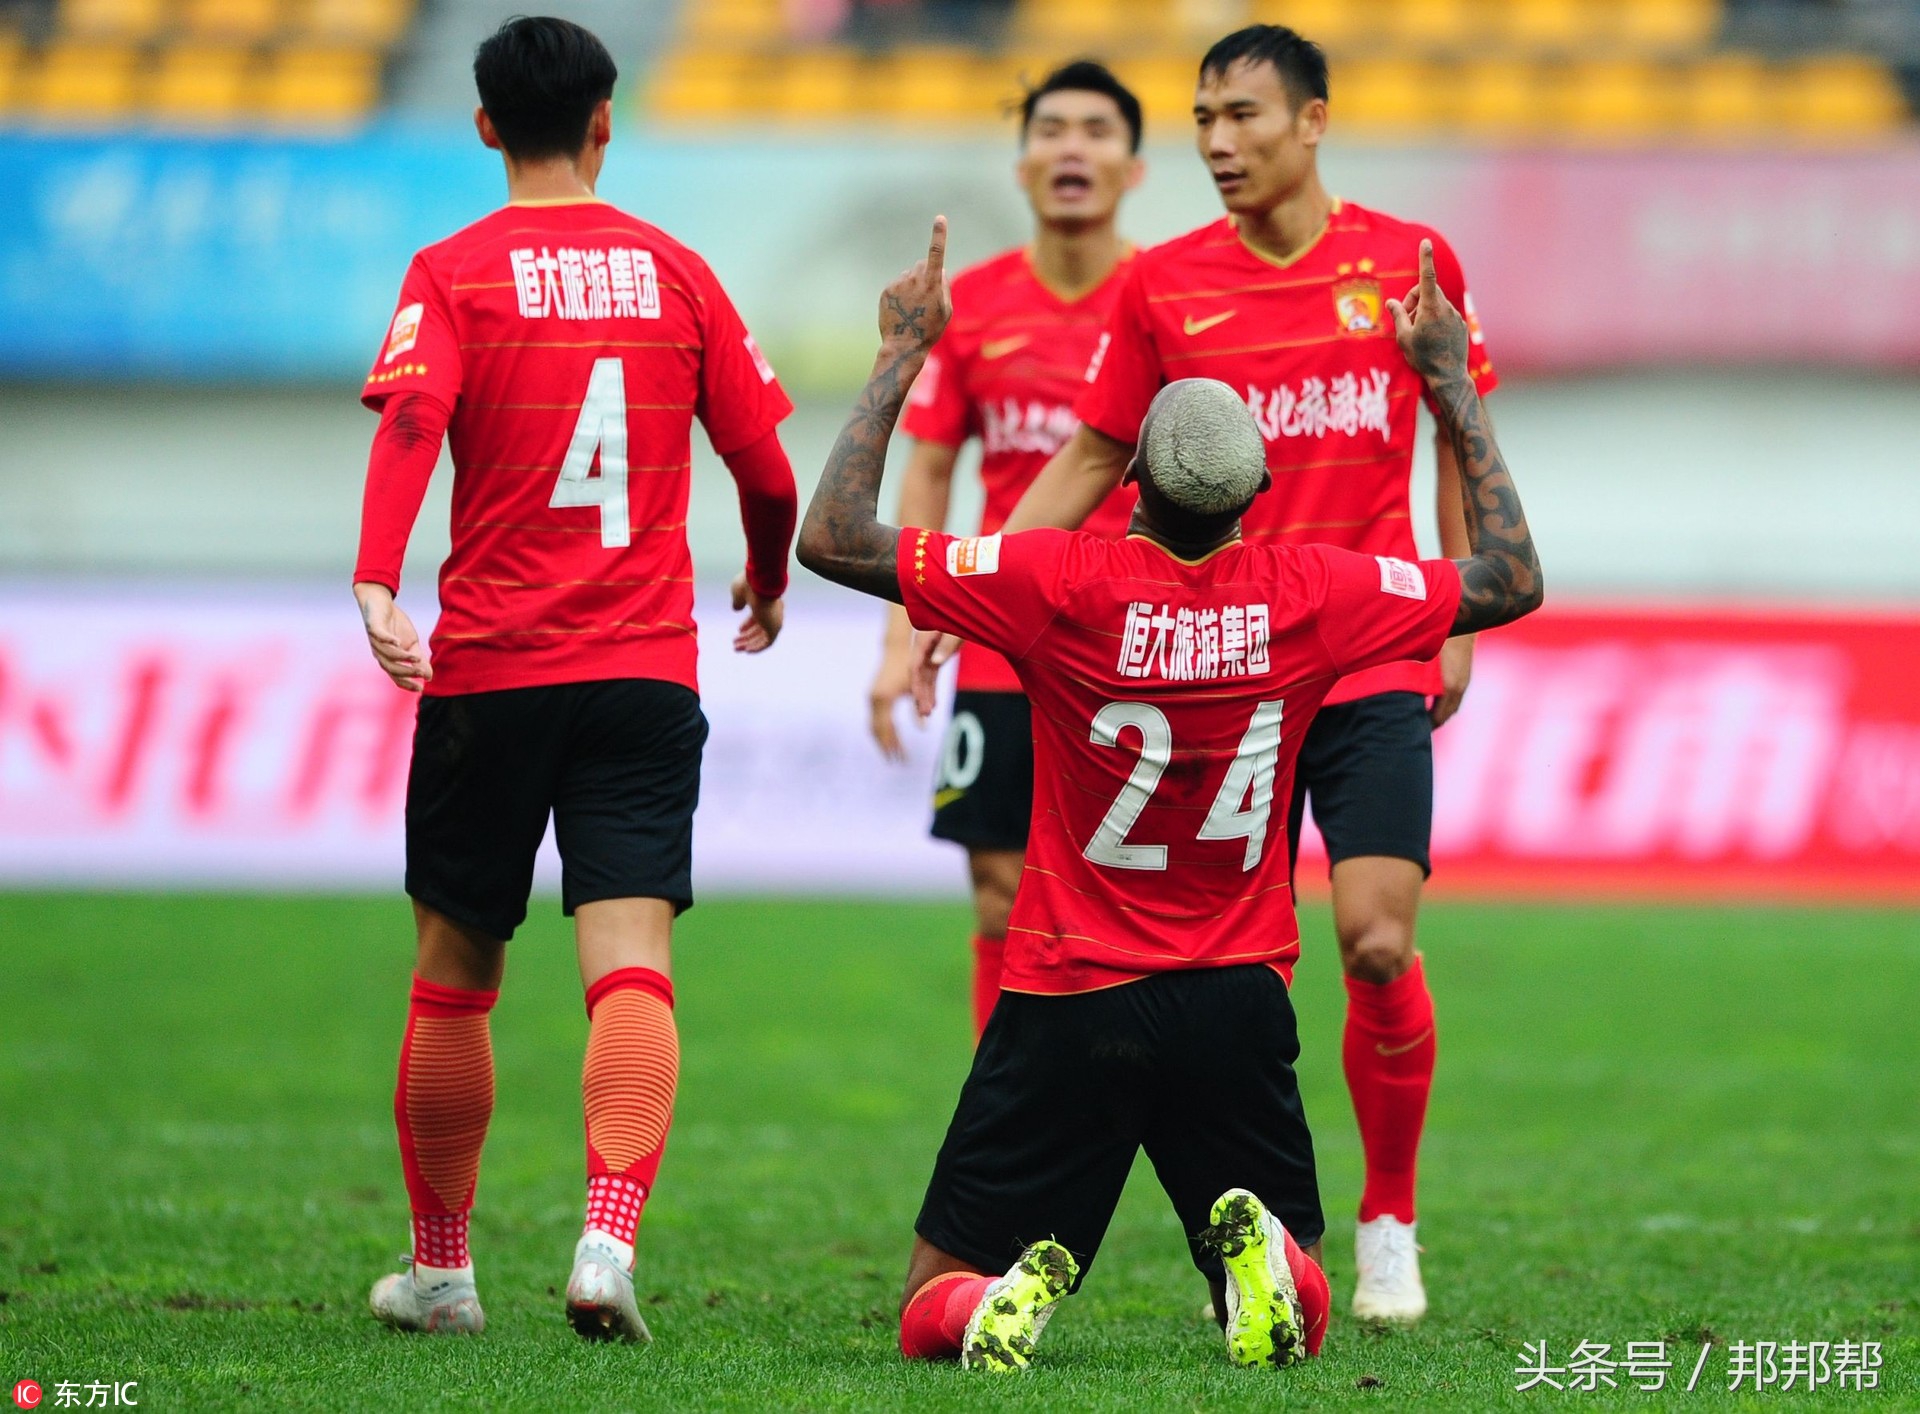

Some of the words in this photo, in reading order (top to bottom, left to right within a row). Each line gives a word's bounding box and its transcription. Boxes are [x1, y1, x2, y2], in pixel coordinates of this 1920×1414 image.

[510, 247, 661, 320] 恒大旅游集团
[548, 357, 631, 548] 4
[1117, 602, 1271, 681] 恒大旅游集团
[1082, 699, 1284, 872] 24
